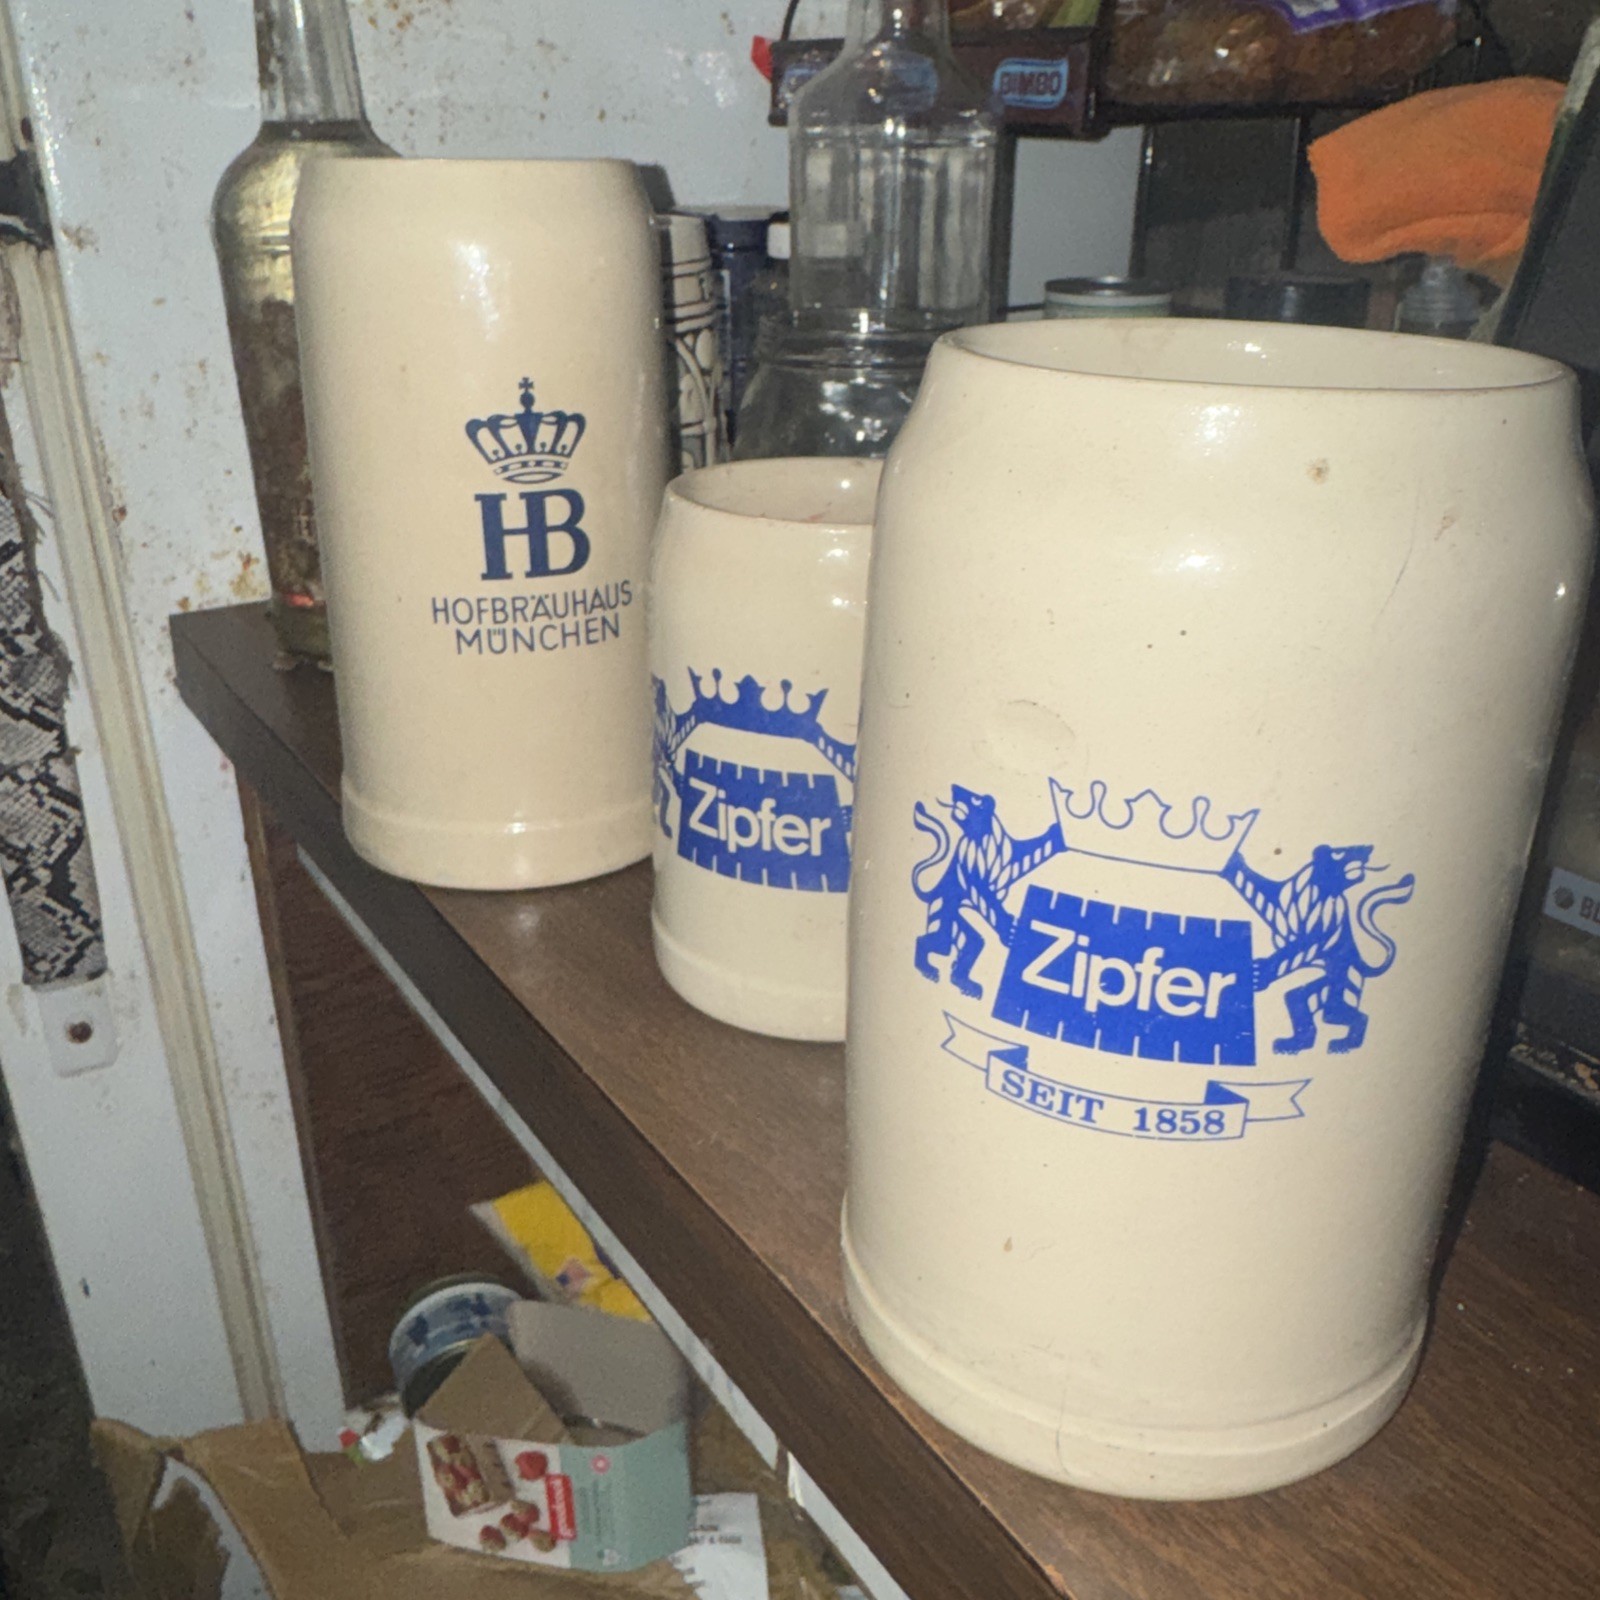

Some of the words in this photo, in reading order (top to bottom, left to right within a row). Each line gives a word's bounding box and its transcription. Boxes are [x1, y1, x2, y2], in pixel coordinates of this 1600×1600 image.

[1000, 70, 1062, 97] BIMBO
[474, 488, 591, 581] HB
[431, 579, 633, 625] HOFBRÄUHAUS
[455, 612, 621, 655] MÜNCHEN
[688, 776, 832, 857] Zipfer
[1021, 920, 1237, 1020] Zipfer
[1001, 1069, 1104, 1124] SEIT
[1132, 1106, 1225, 1136] 1858
